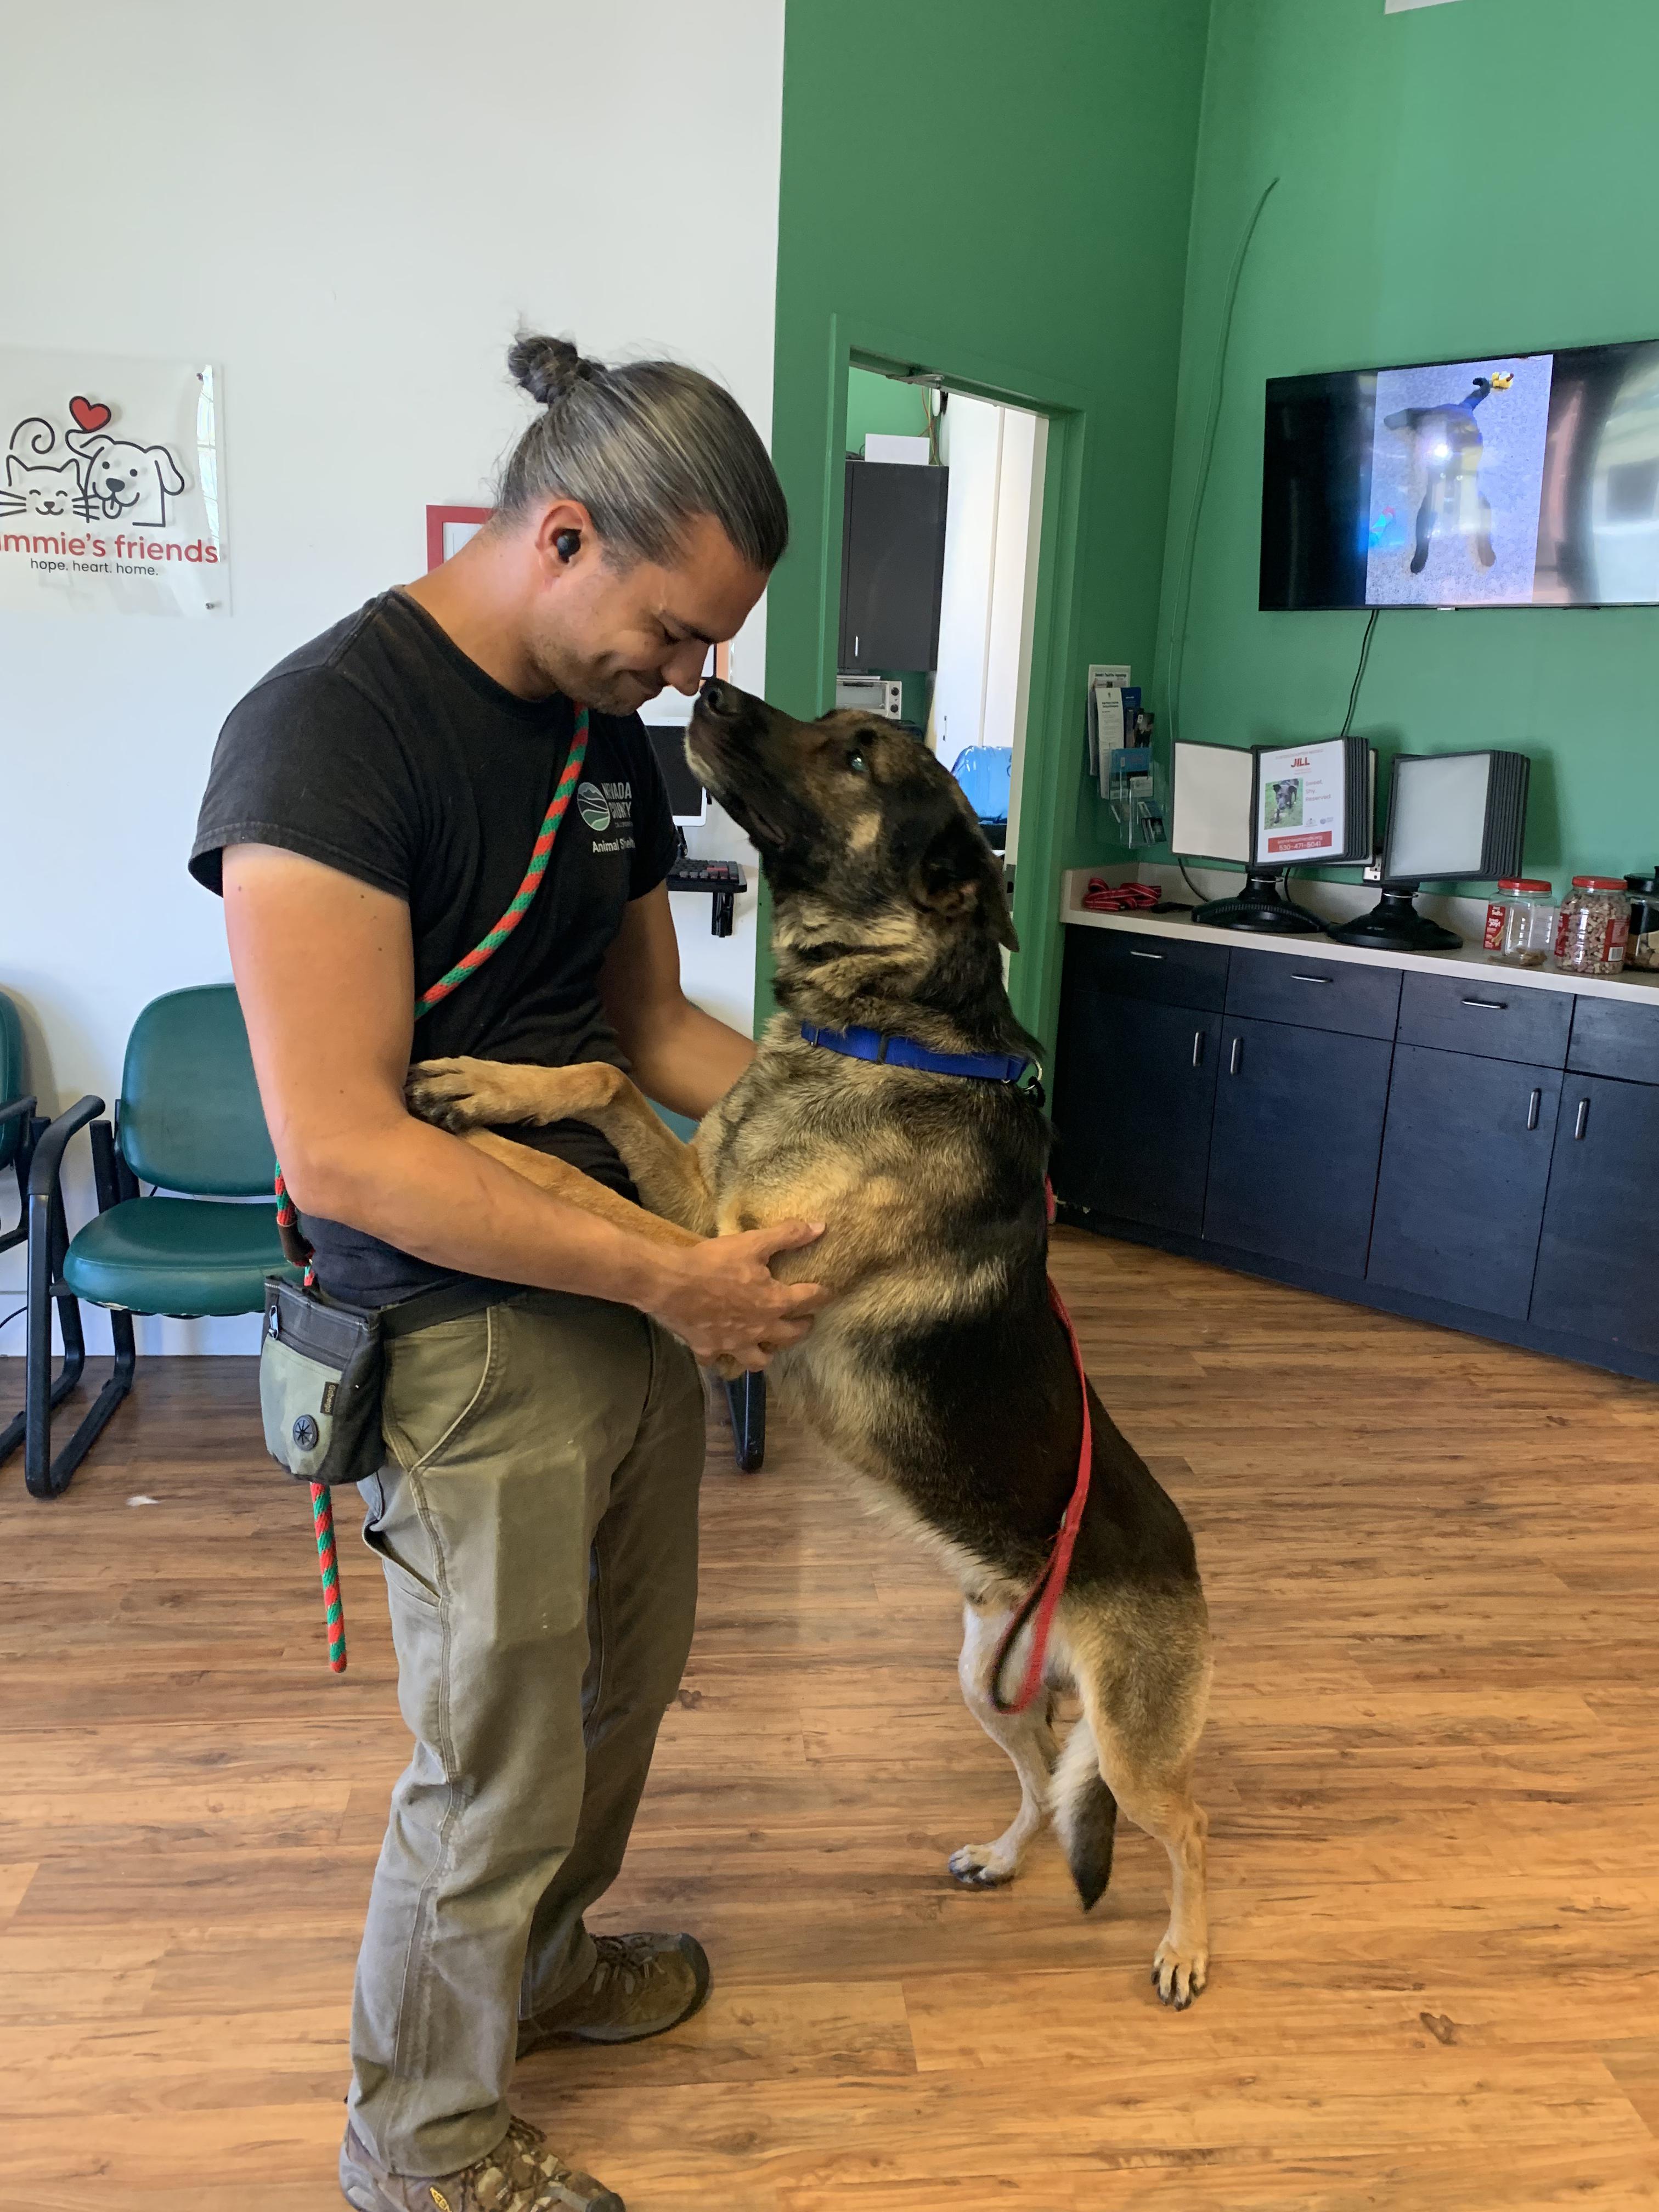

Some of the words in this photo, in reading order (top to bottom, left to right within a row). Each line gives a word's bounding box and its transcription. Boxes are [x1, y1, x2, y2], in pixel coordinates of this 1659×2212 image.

[0, 532, 106, 557] mmie's
[114, 534, 218, 563] friends
[30, 558, 69, 573] hope.
[72, 560, 112, 573] heart.
[116, 562, 159, 575] home.
[1291, 757, 1310, 768] JILL
[592, 838, 620, 853] Animal
